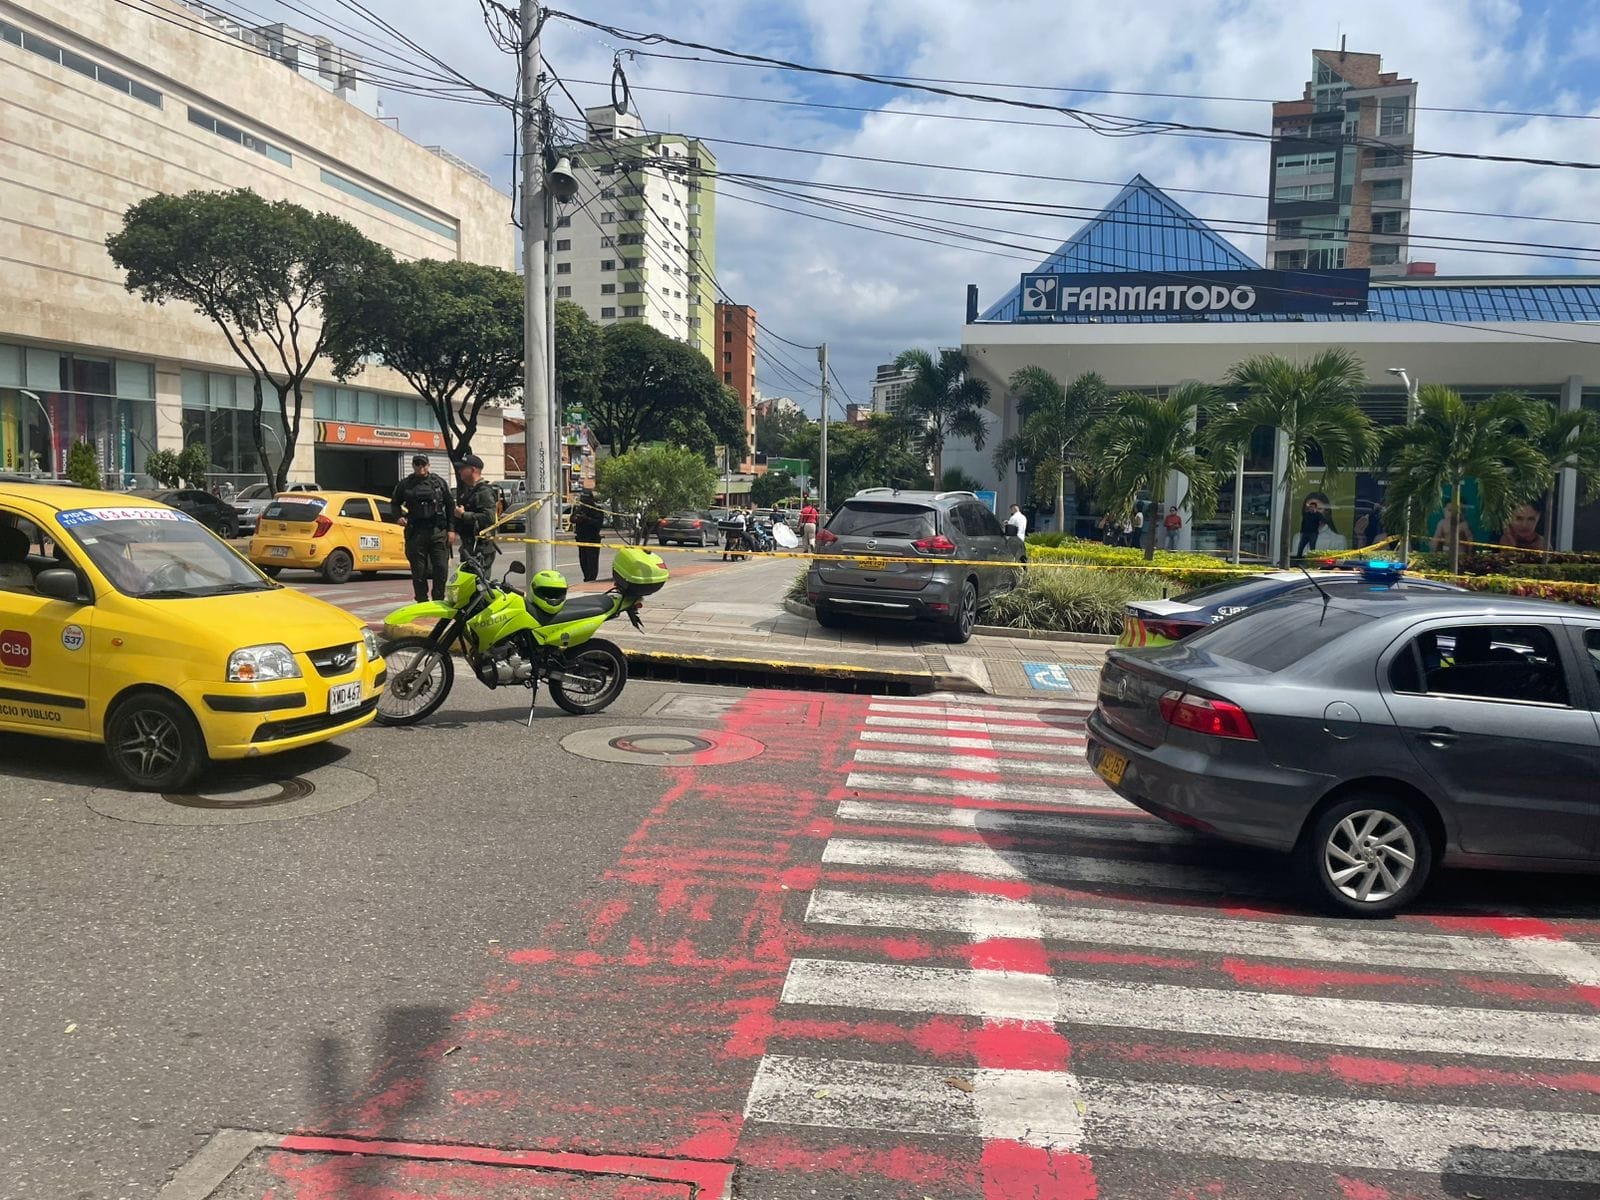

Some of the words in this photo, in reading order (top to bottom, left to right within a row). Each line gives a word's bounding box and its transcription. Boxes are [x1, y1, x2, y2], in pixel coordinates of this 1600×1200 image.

[1062, 285, 1256, 311] FARMATODO
[62, 511, 86, 519] PIDE
[77, 515, 98, 523] TAXI
[98, 510, 175, 519] 634-2222
[473, 614, 508, 628] POLICIA
[64, 635, 81, 646] 537
[347, 684, 360, 701] 467
[20, 706, 61, 721] PUBLICO
